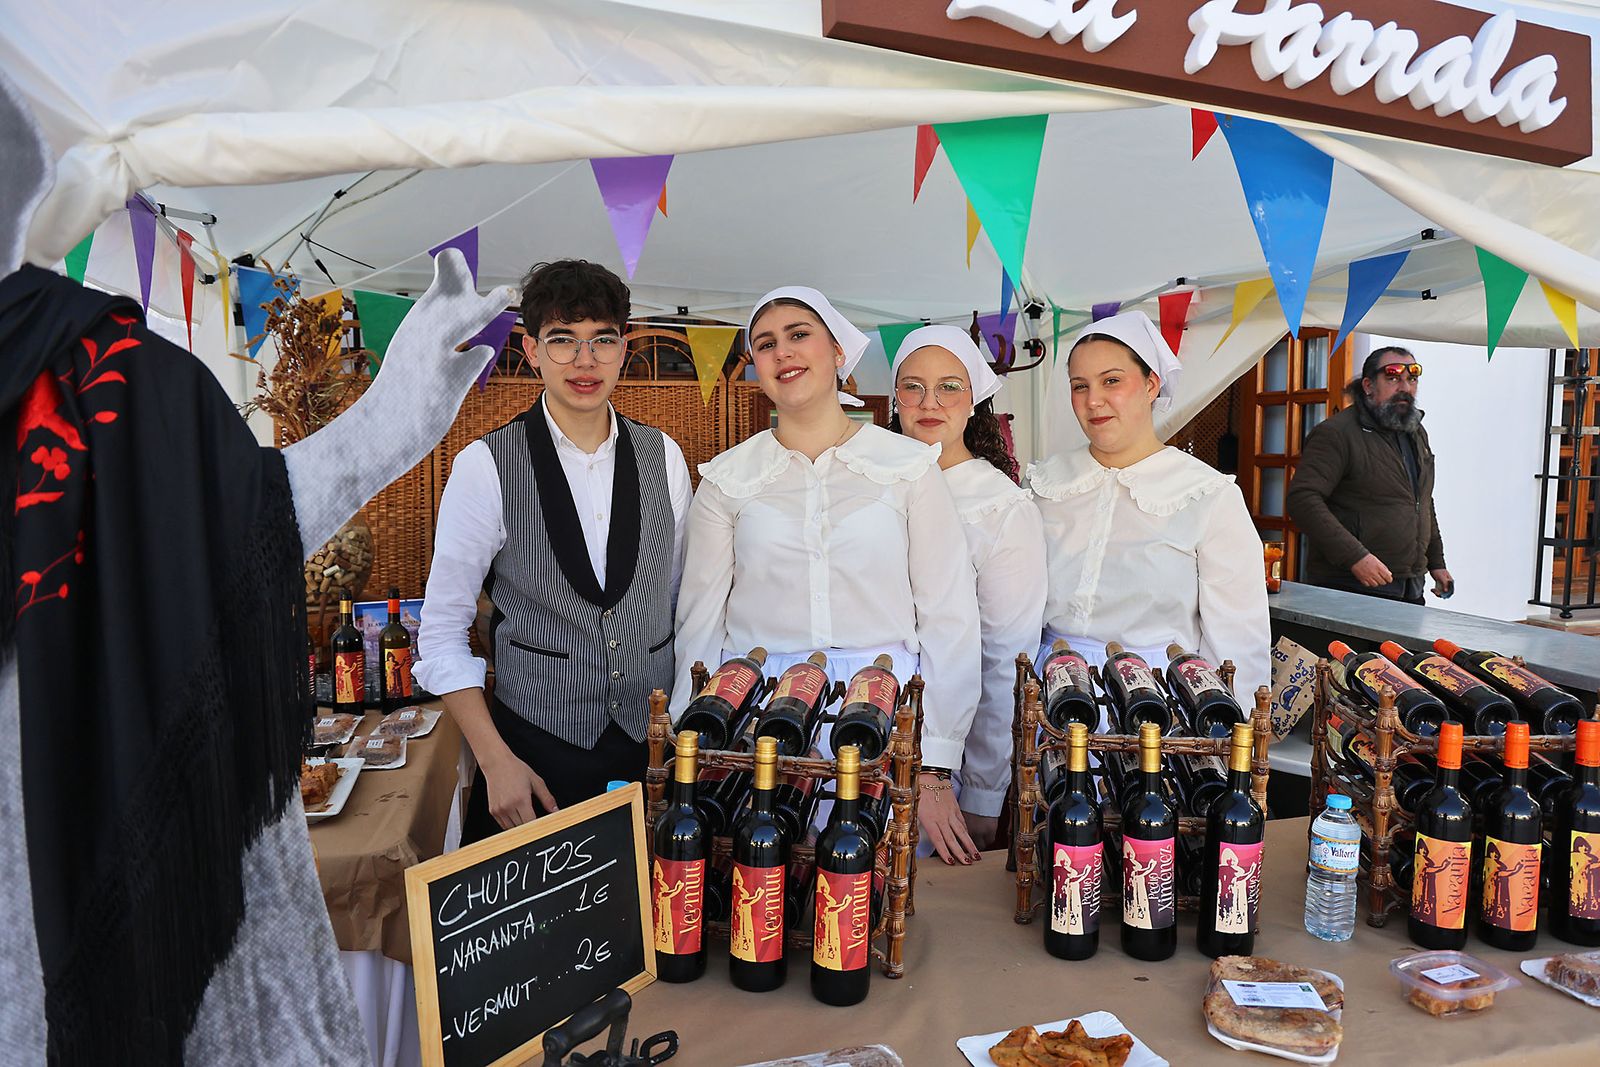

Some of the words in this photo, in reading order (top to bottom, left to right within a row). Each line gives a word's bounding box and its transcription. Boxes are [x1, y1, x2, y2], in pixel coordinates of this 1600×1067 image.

[1184, 0, 1567, 134] Parrala
[679, 861, 702, 935] Vermut
[761, 868, 782, 943] Vermut
[847, 874, 868, 951] Vermut
